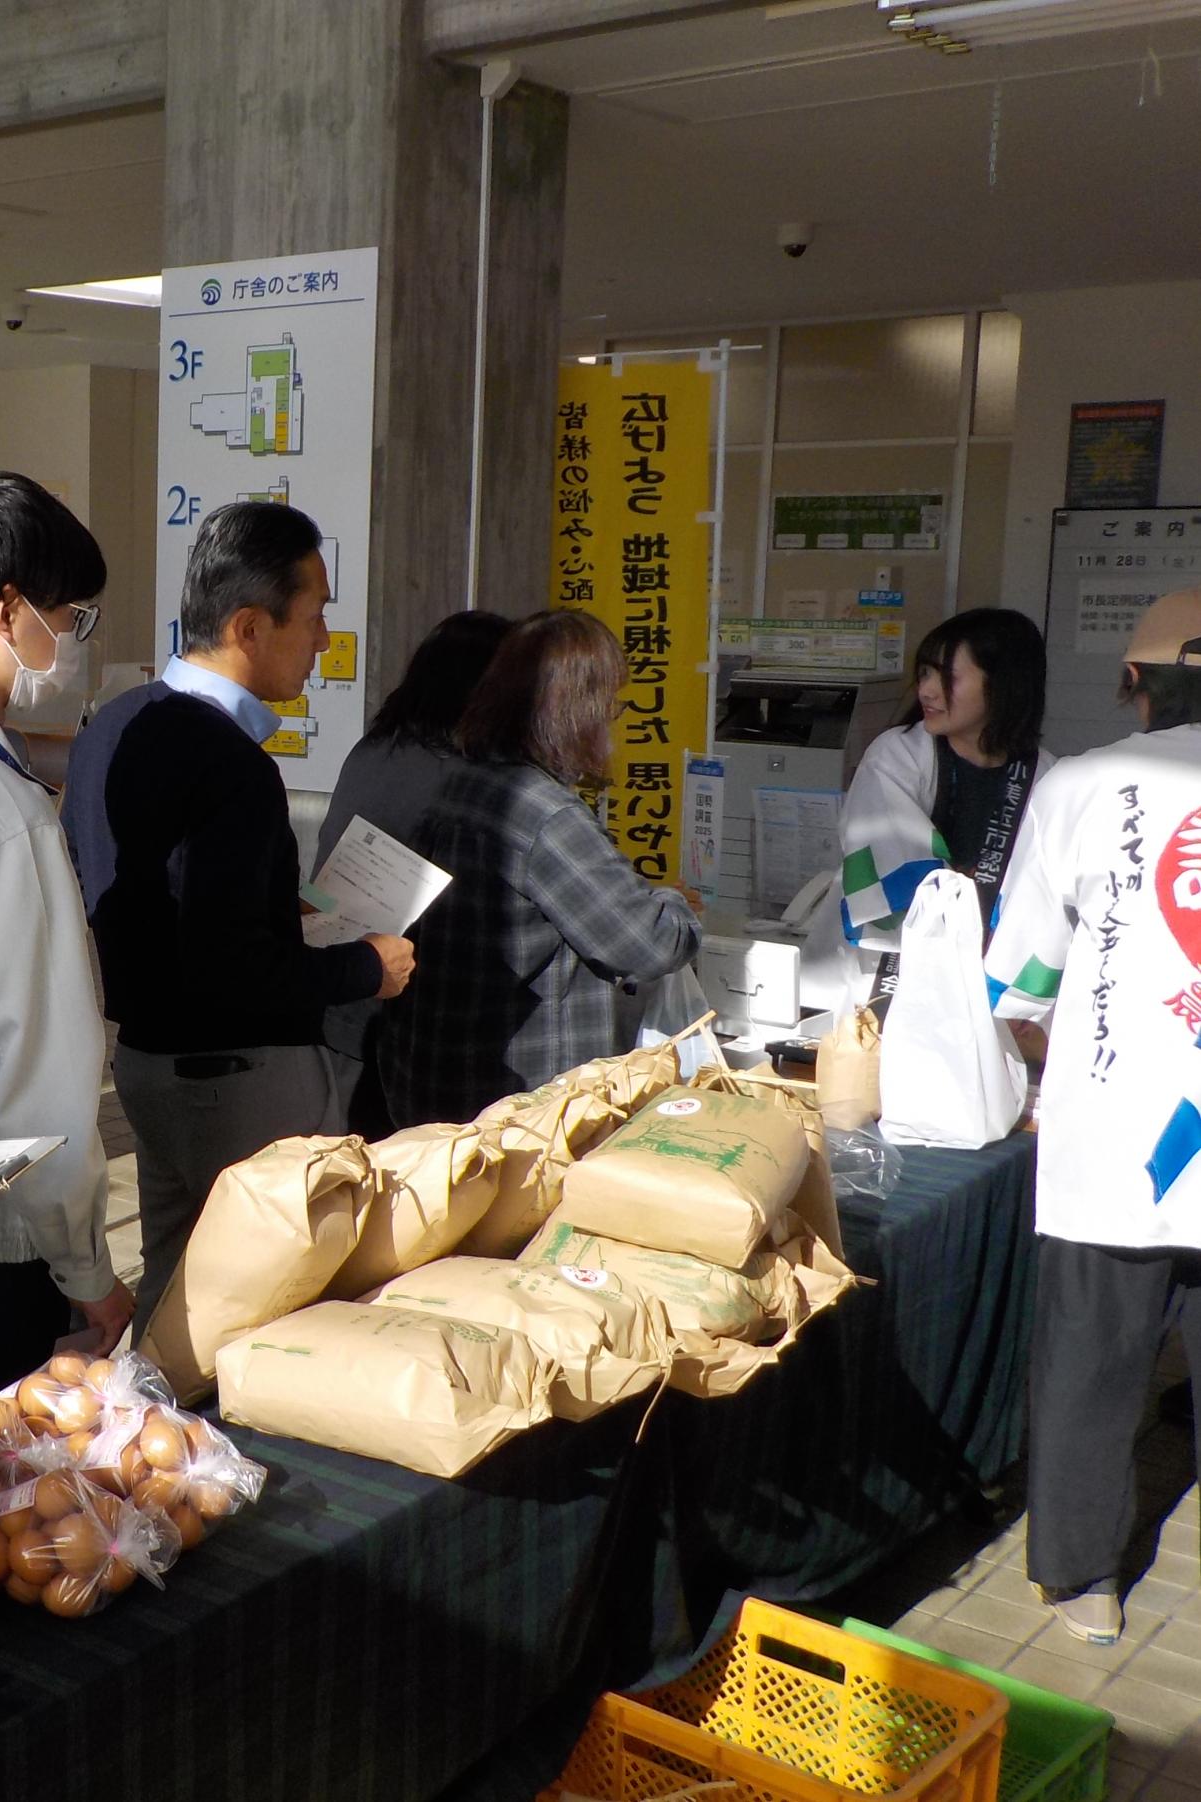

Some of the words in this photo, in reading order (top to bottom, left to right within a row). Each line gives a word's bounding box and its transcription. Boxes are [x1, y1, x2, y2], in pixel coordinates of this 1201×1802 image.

[231, 269, 339, 300] 庁舎のご案内
[168, 339, 204, 382] 3F
[167, 485, 201, 525] 2F
[1102, 520, 1185, 537] ご案内
